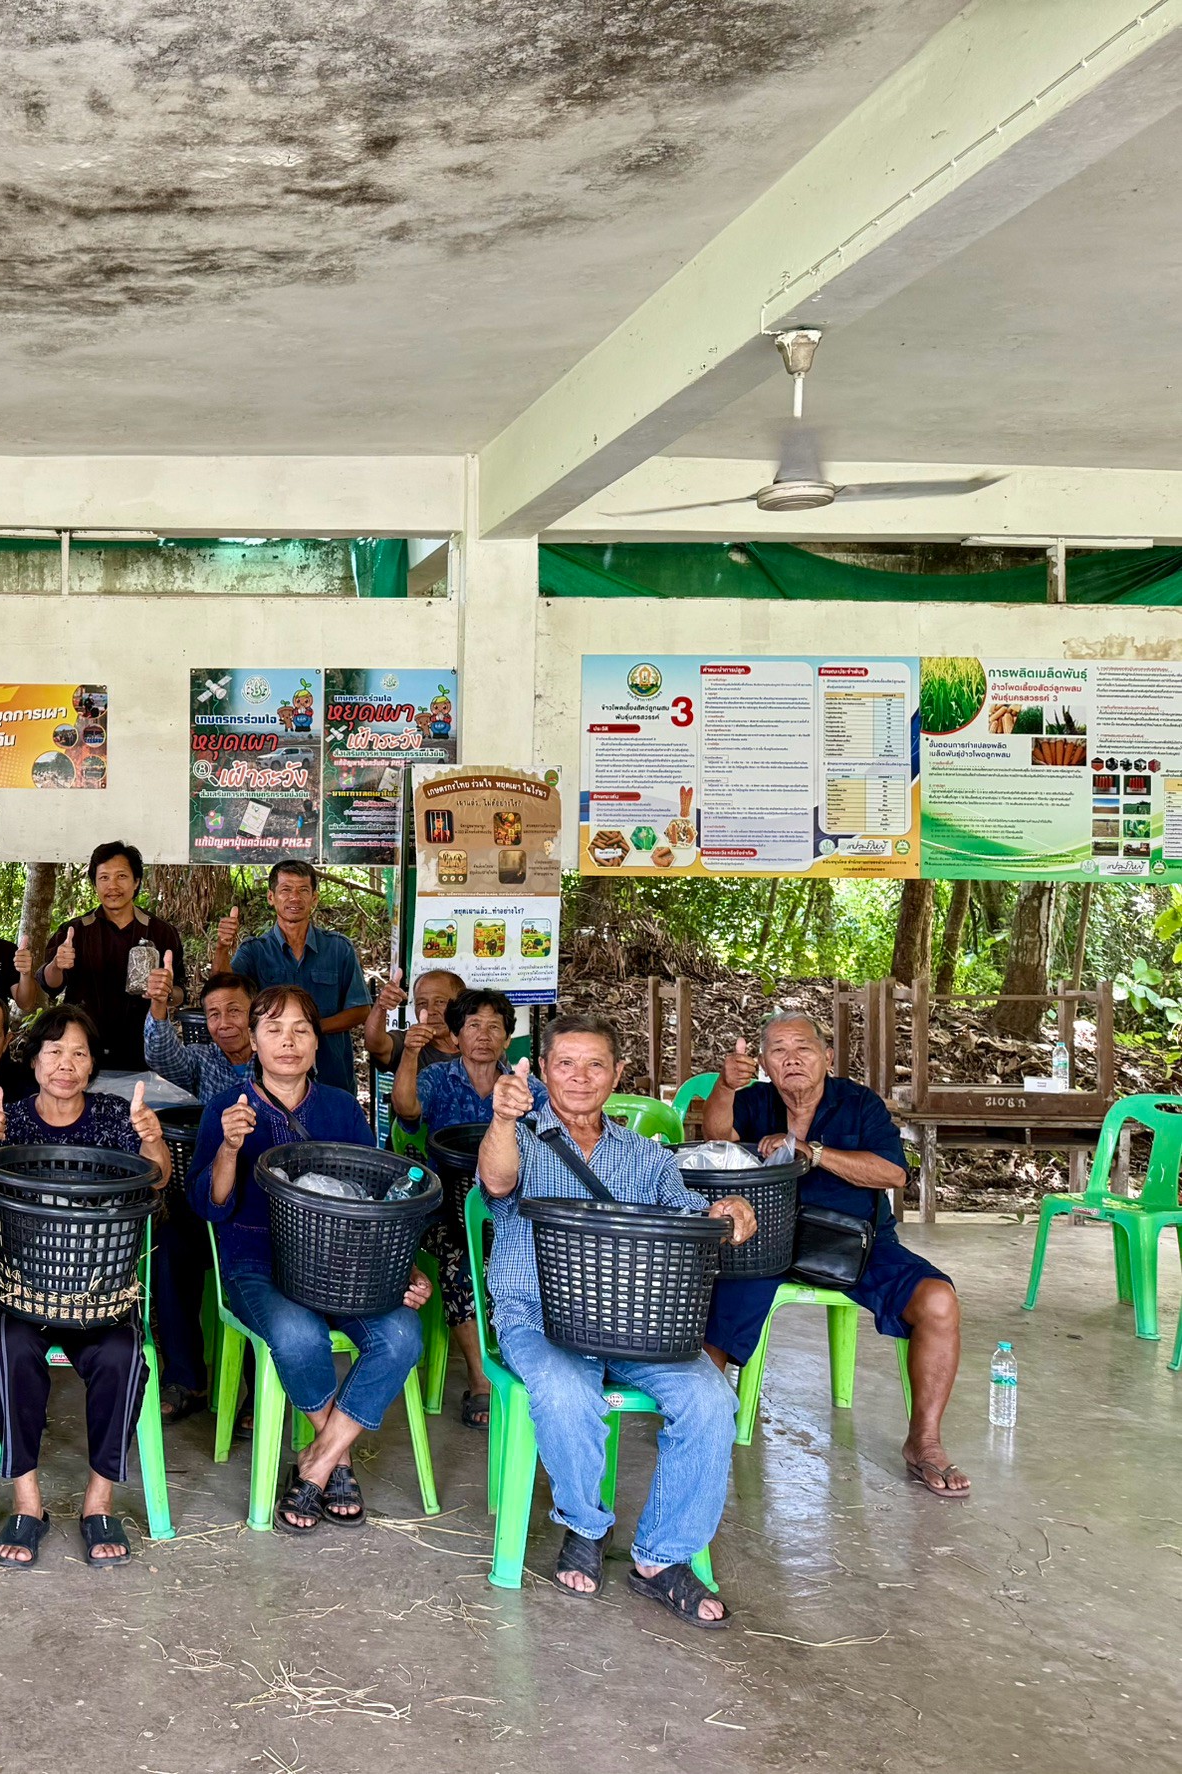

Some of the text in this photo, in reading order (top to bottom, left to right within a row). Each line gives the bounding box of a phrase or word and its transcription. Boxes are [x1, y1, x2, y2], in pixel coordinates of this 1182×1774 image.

[988, 666, 1088, 682] การผลิตเมล็ดพันธุ์
[991, 682, 1082, 693] ข้าวโพดเลี้ยงสัตว์ลูกผสม
[334, 694, 392, 702] เกษตรกรร่วมใจ
[991, 693, 1050, 703] พันธุ์นครสวรรค์
[602, 703, 670, 712] ข้าวโพดเลี้ยงสัตว์ลูกผสม
[615, 696, 694, 727] พันธุ์นครสวรรค์ 3
[195, 713, 277, 725] เกษตรกรร่วมใจ
[327, 703, 416, 731] หยุดเผา
[346, 726, 423, 750] เฝ้าระวัง
[191, 733, 279, 761] หยุดเผา
[929, 740, 1007, 749] ขั้นตอนการทำแปลงผลิต
[929, 750, 1011, 760] เมล็ดพันธุ์ข้าวโพดลูกผสม
[218, 760, 308, 788] เฝ้าระวัง
[426, 778, 547, 798] เกษตรกรไทย ร่วมใจ หยุดเผา ในไร่นา
[281, 838, 312, 848] PM2.5
